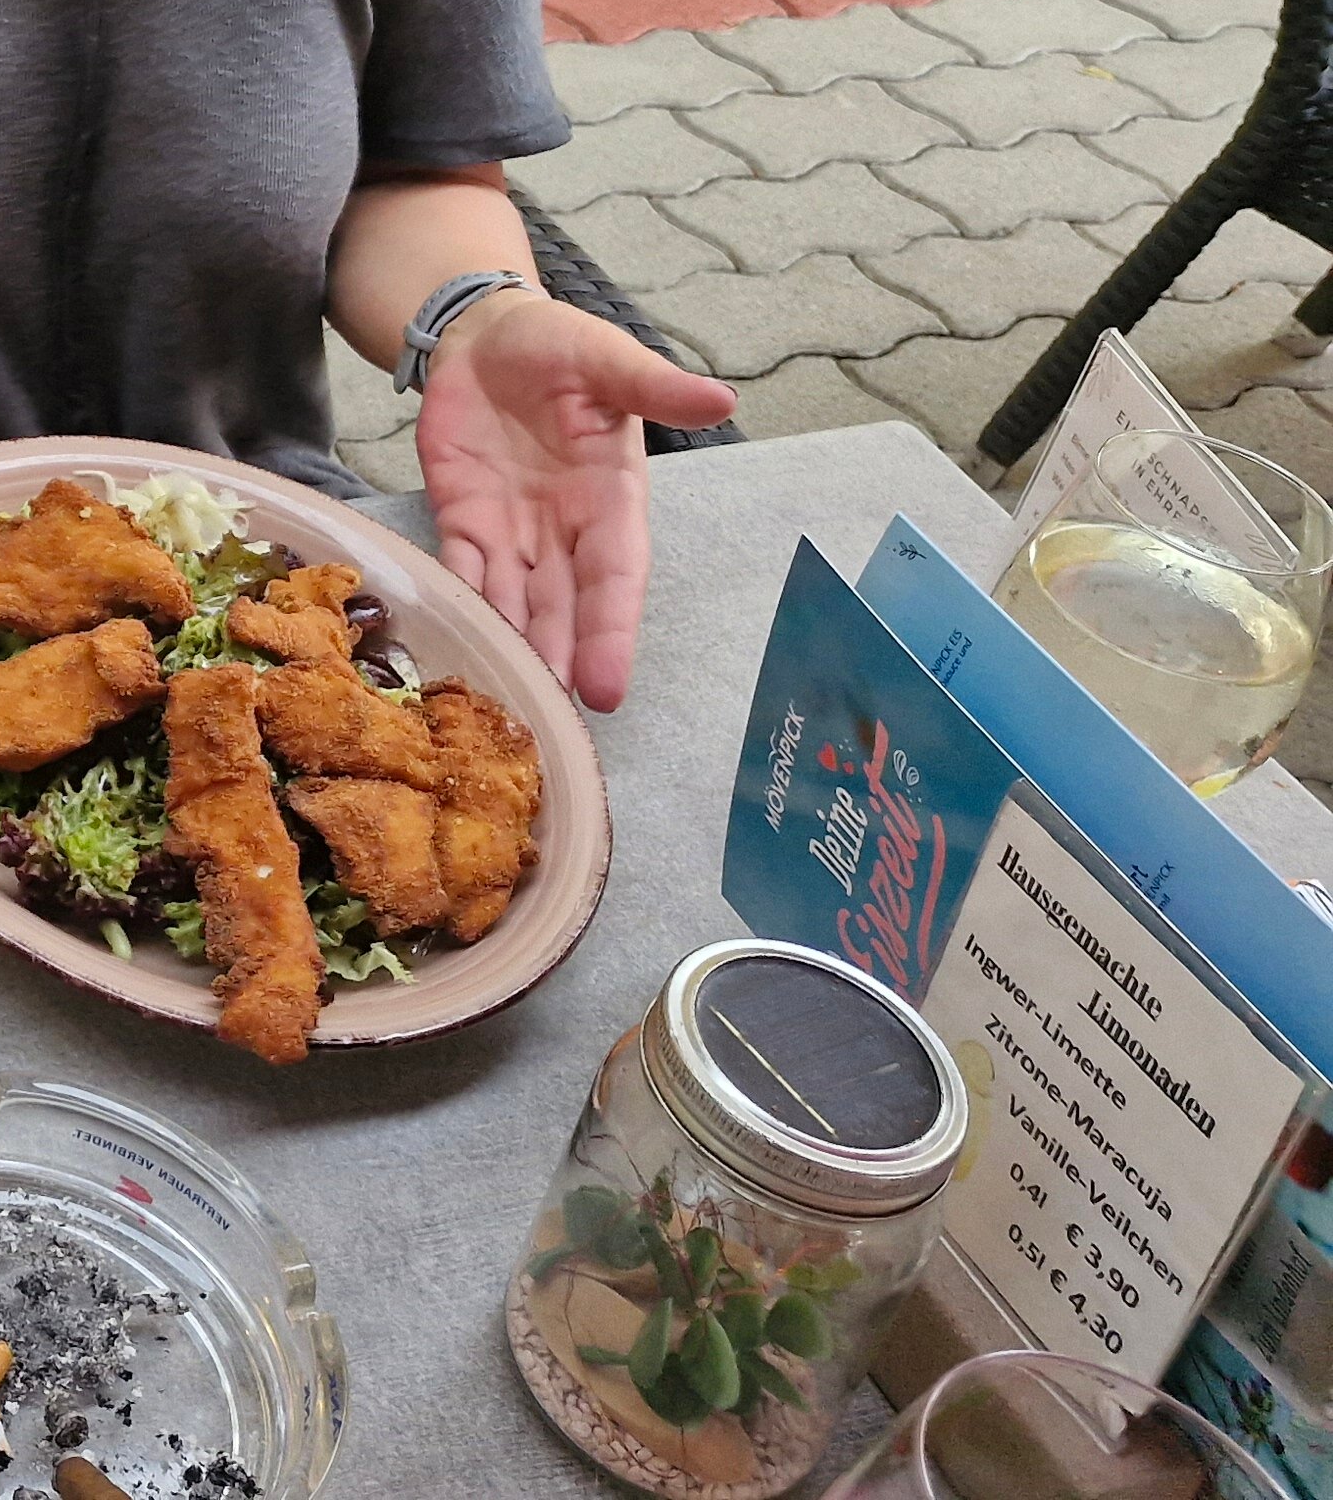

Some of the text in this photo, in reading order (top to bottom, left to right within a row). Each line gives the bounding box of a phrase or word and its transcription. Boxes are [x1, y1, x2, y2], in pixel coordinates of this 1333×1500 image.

[930, 627, 963, 675] NPICK EIS
[765, 700, 806, 834] MÖVENPICK
[809, 786, 869, 897] Deine
[836, 718, 923, 988] Eiszeit
[1130, 863, 1149, 888] rt
[1144, 860, 1175, 900] ENPICK
[998, 843, 1164, 1021] Hausgemachte
[965, 934, 1128, 1110] Ingwer-Limette
[1079, 988, 1217, 1138] Limonaden
[984, 1012, 1174, 1222] Zitrone-Maracuja
[1007, 1093, 1185, 1296] Vanille-Veilchen
[1009, 1162, 1141, 1309] 0,4l € 3,90
[1008, 1223, 1045, 1271] 0,5l
[1049, 1267, 1069, 1294] €
[1069, 1292, 1124, 1355] 4,30
